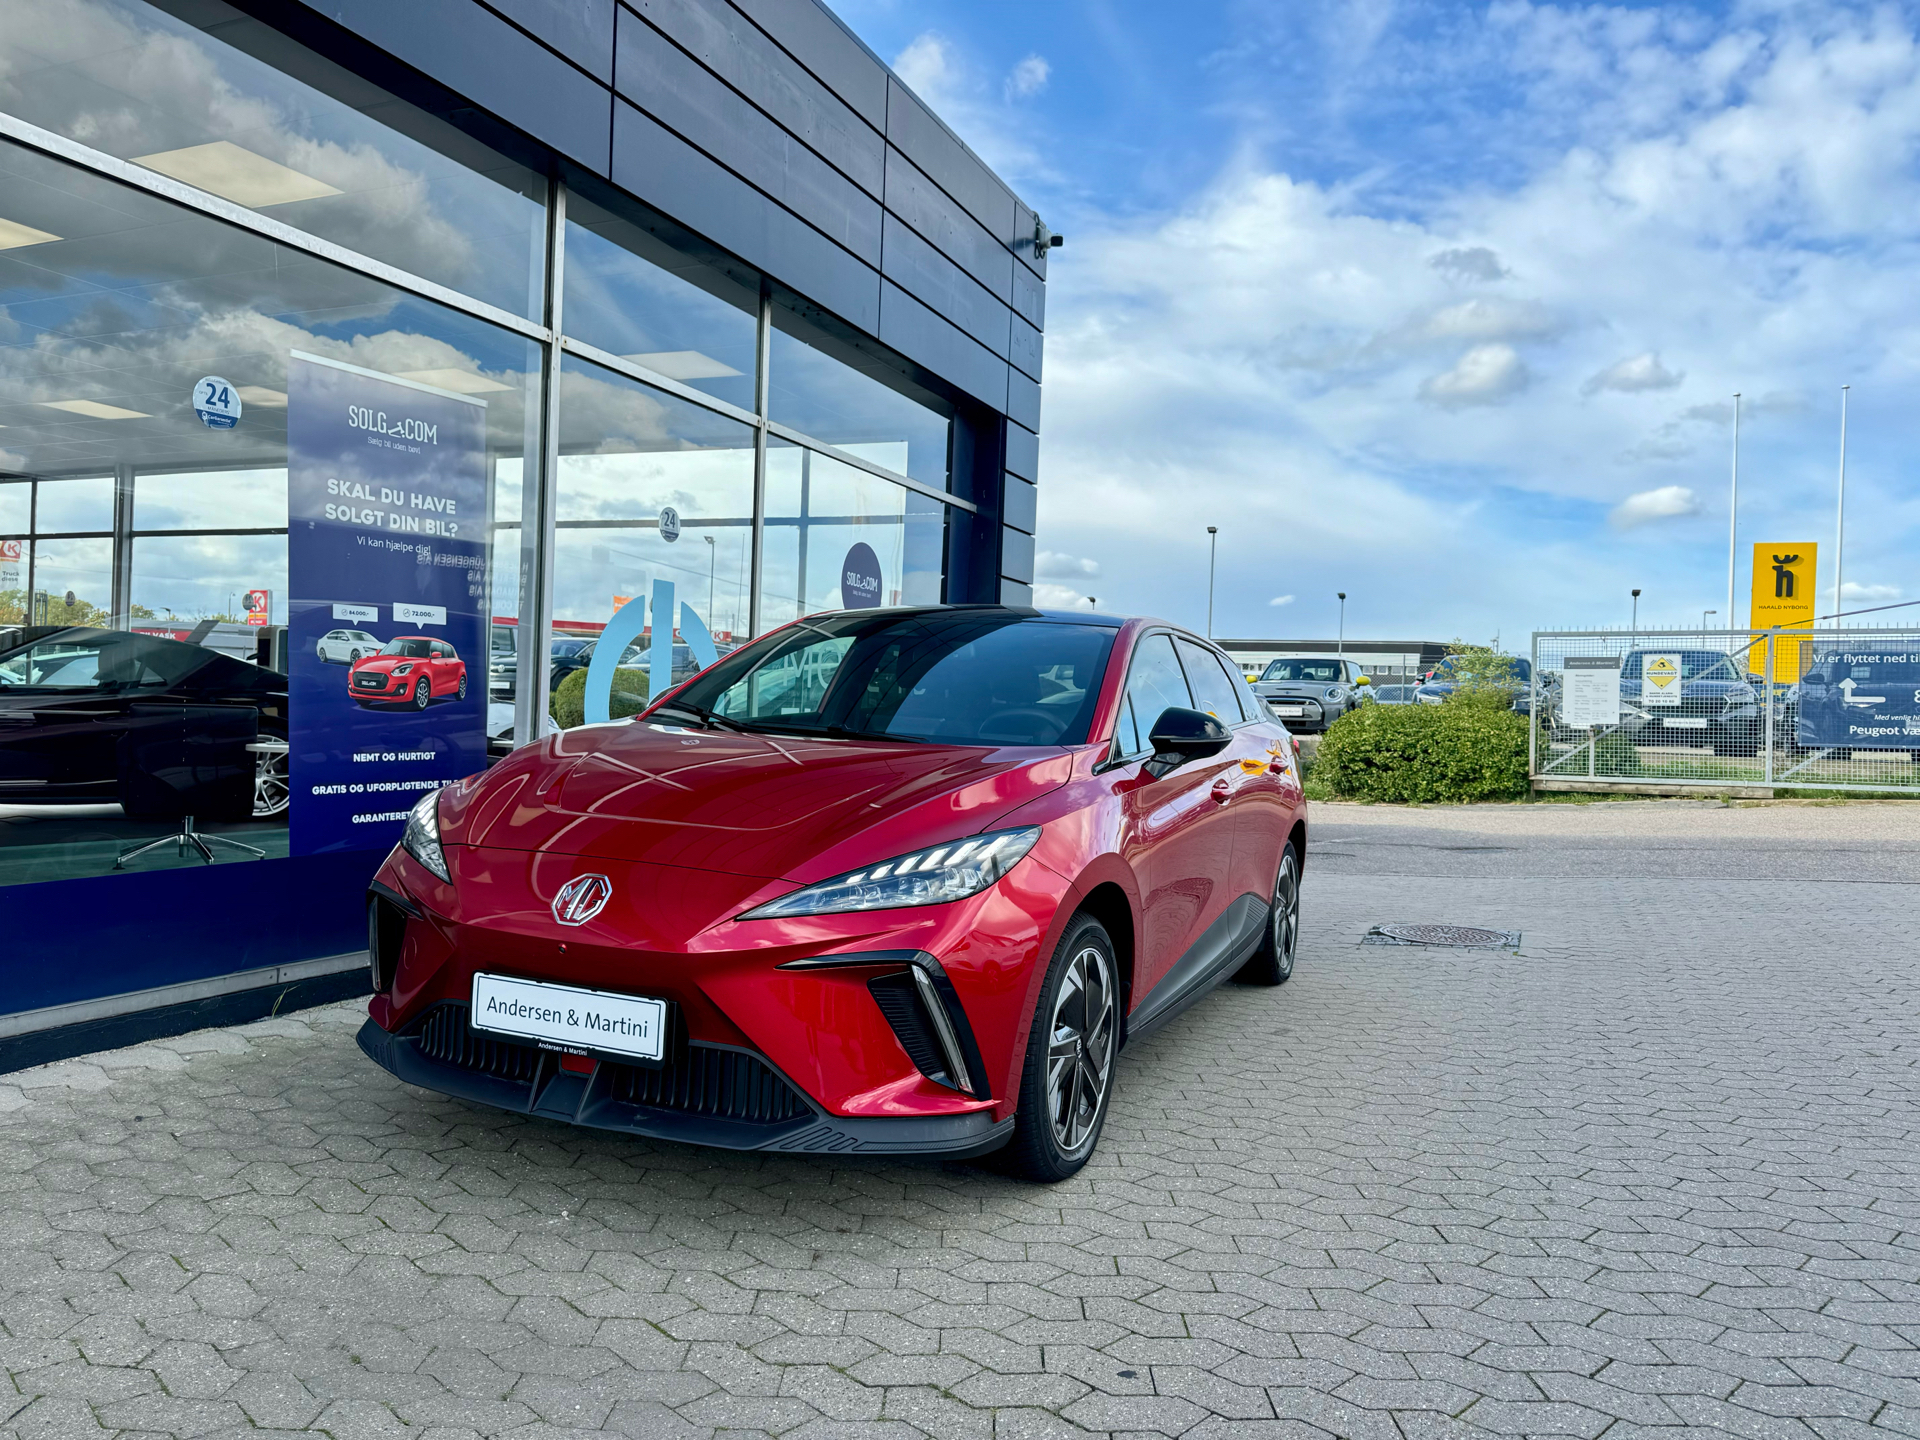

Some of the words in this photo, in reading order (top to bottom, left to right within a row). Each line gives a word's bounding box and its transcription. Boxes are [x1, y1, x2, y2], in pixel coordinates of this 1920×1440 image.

[205, 382, 230, 409] 24
[327, 478, 376, 501] SKAL
[381, 487, 405, 506] DU
[410, 492, 456, 514] HAVE
[325, 503, 385, 527] SOLGT
[389, 513, 419, 532] DIN
[425, 518, 458, 537] BIL?
[664, 511, 676, 529] 24
[356, 535, 366, 545] Vi
[368, 537, 384, 548] kan
[385, 539, 414, 553] hjælpe
[415, 545, 431, 557] dig!
[411, 610, 435, 618] 72.000,-
[1813, 653, 1825, 663] Vi
[1827, 655, 1840, 663] er
[1843, 653, 1881, 666] flyttet
[1883, 653, 1907, 663] ned
[1890, 714, 1912, 724] venlig
[1849, 725, 1900, 737] Peugeot
[353, 753, 380, 762] NEMT
[381, 752, 396, 762] OG
[398, 751, 436, 761] HURTIGT
[312, 785, 347, 795] GRATIS
[349, 784, 364, 793] OG
[366, 780, 439, 792] UFORPLIGTENDE
[556, 878, 607, 921] MG
[486, 996, 562, 1024] Andersen
[566, 1008, 580, 1027] &
[584, 1011, 648, 1038] Martini
[537, 1041, 563, 1052] Andersen
[569, 1047, 588, 1056] Martini
